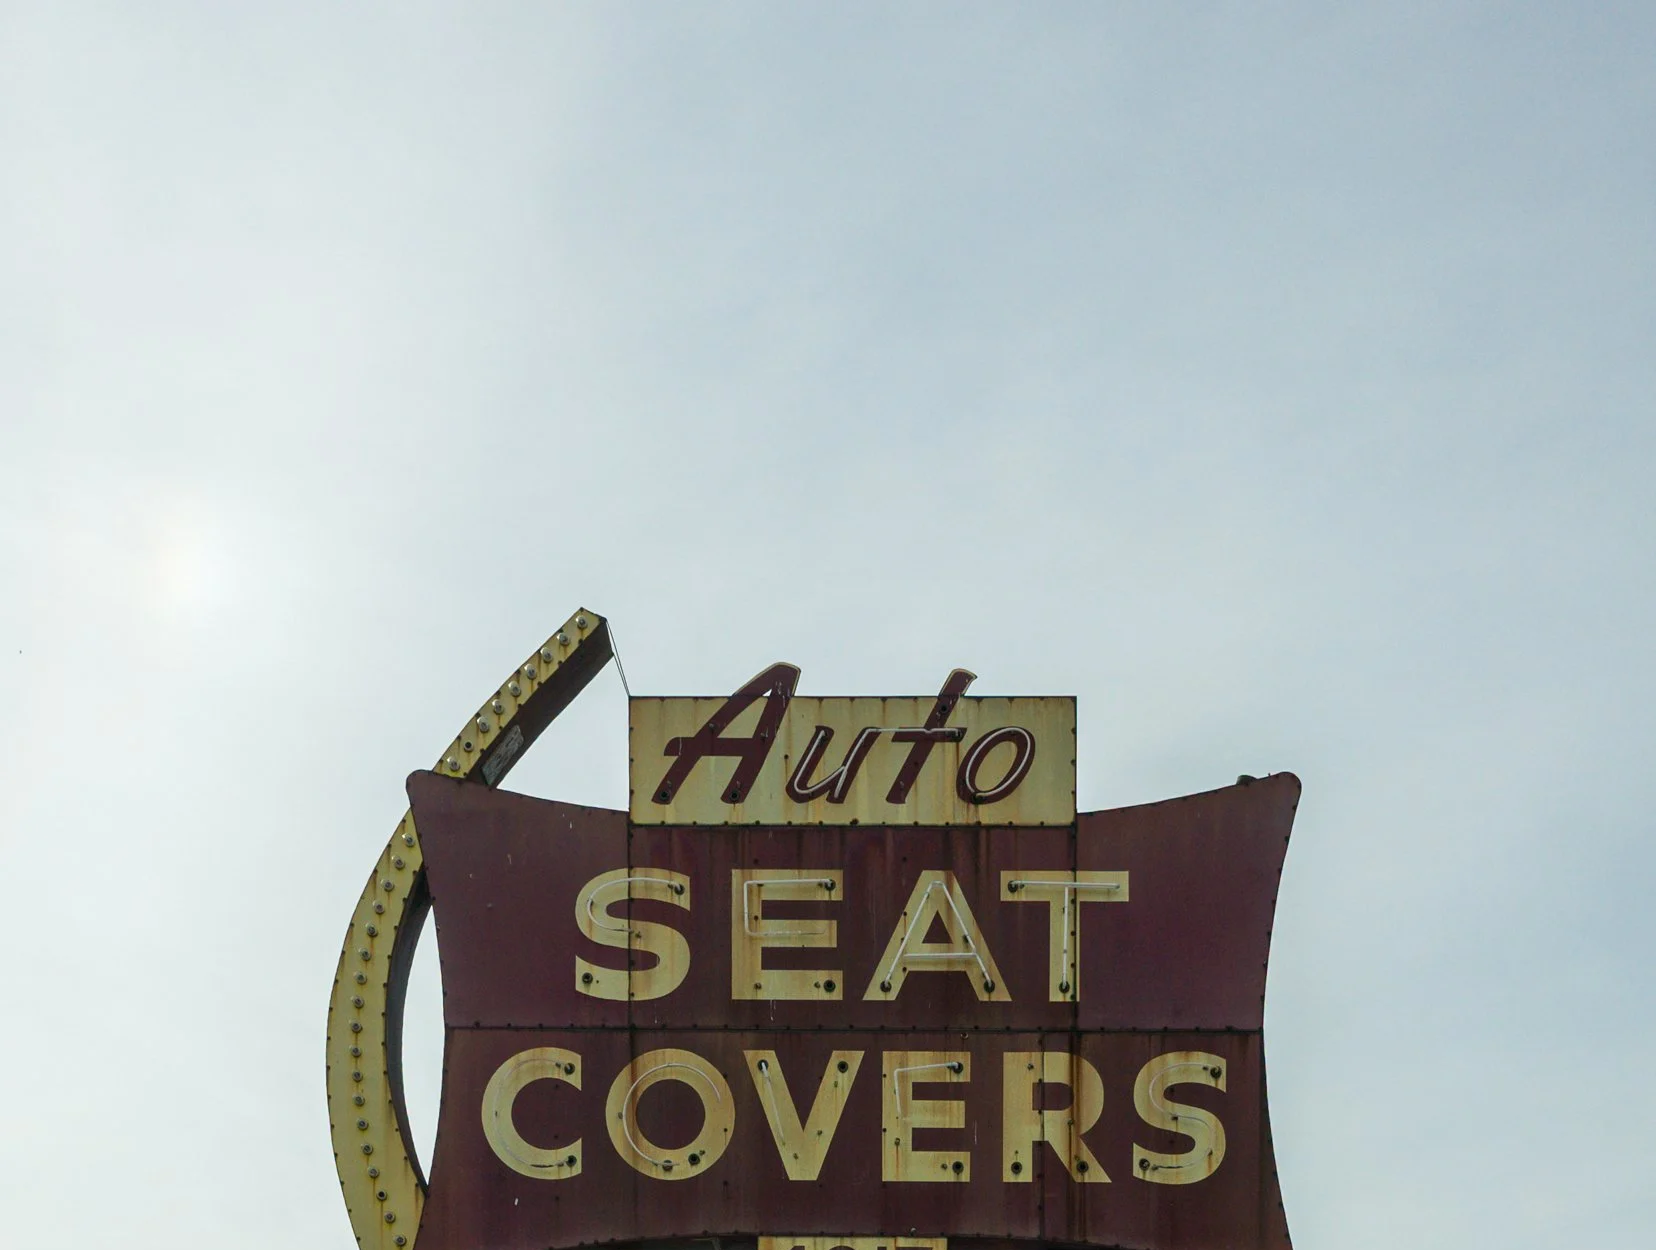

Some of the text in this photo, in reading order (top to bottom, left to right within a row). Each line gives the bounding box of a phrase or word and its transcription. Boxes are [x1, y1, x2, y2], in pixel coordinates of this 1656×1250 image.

[651, 662, 1035, 805] Auto
[575, 867, 1129, 1002] SEAT
[482, 1047, 1226, 1184] COVERS
